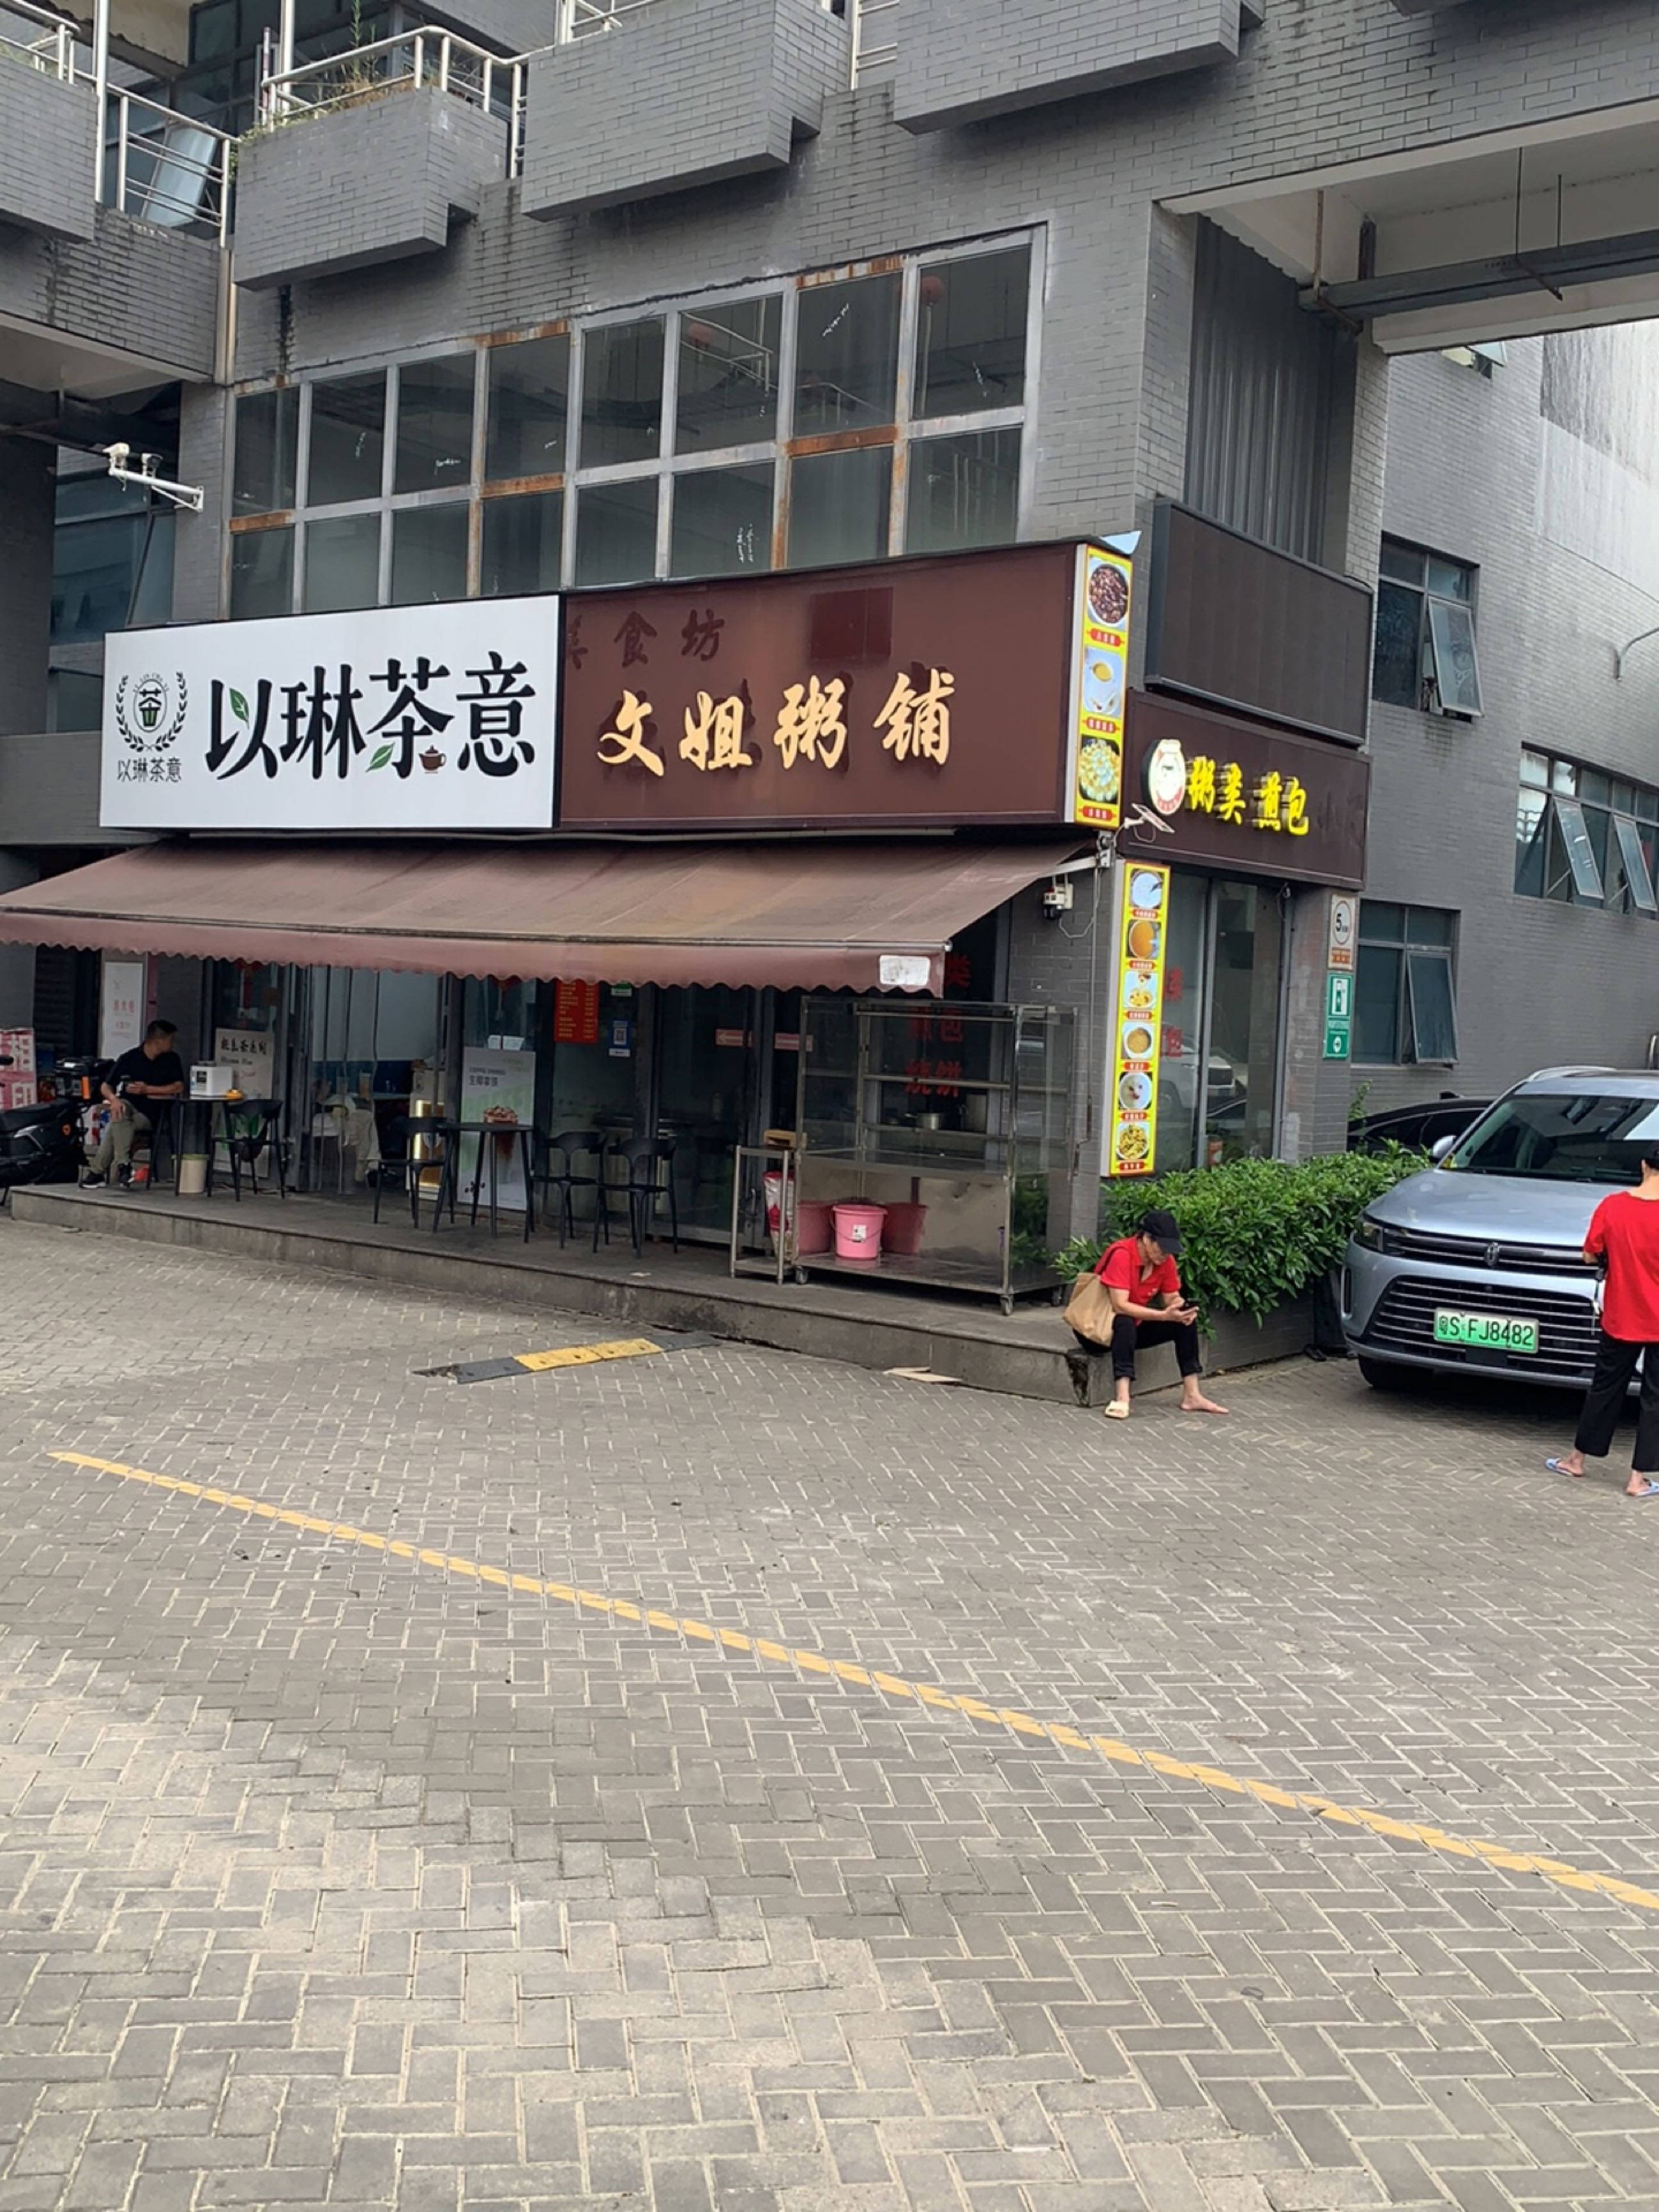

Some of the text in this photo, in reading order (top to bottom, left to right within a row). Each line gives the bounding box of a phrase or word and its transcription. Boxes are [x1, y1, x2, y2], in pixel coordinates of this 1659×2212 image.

[206, 650, 536, 780] 以琳茶意
[597, 668, 956, 776] 文姐粥铺
[117, 757, 182, 783] 以琳茶意
